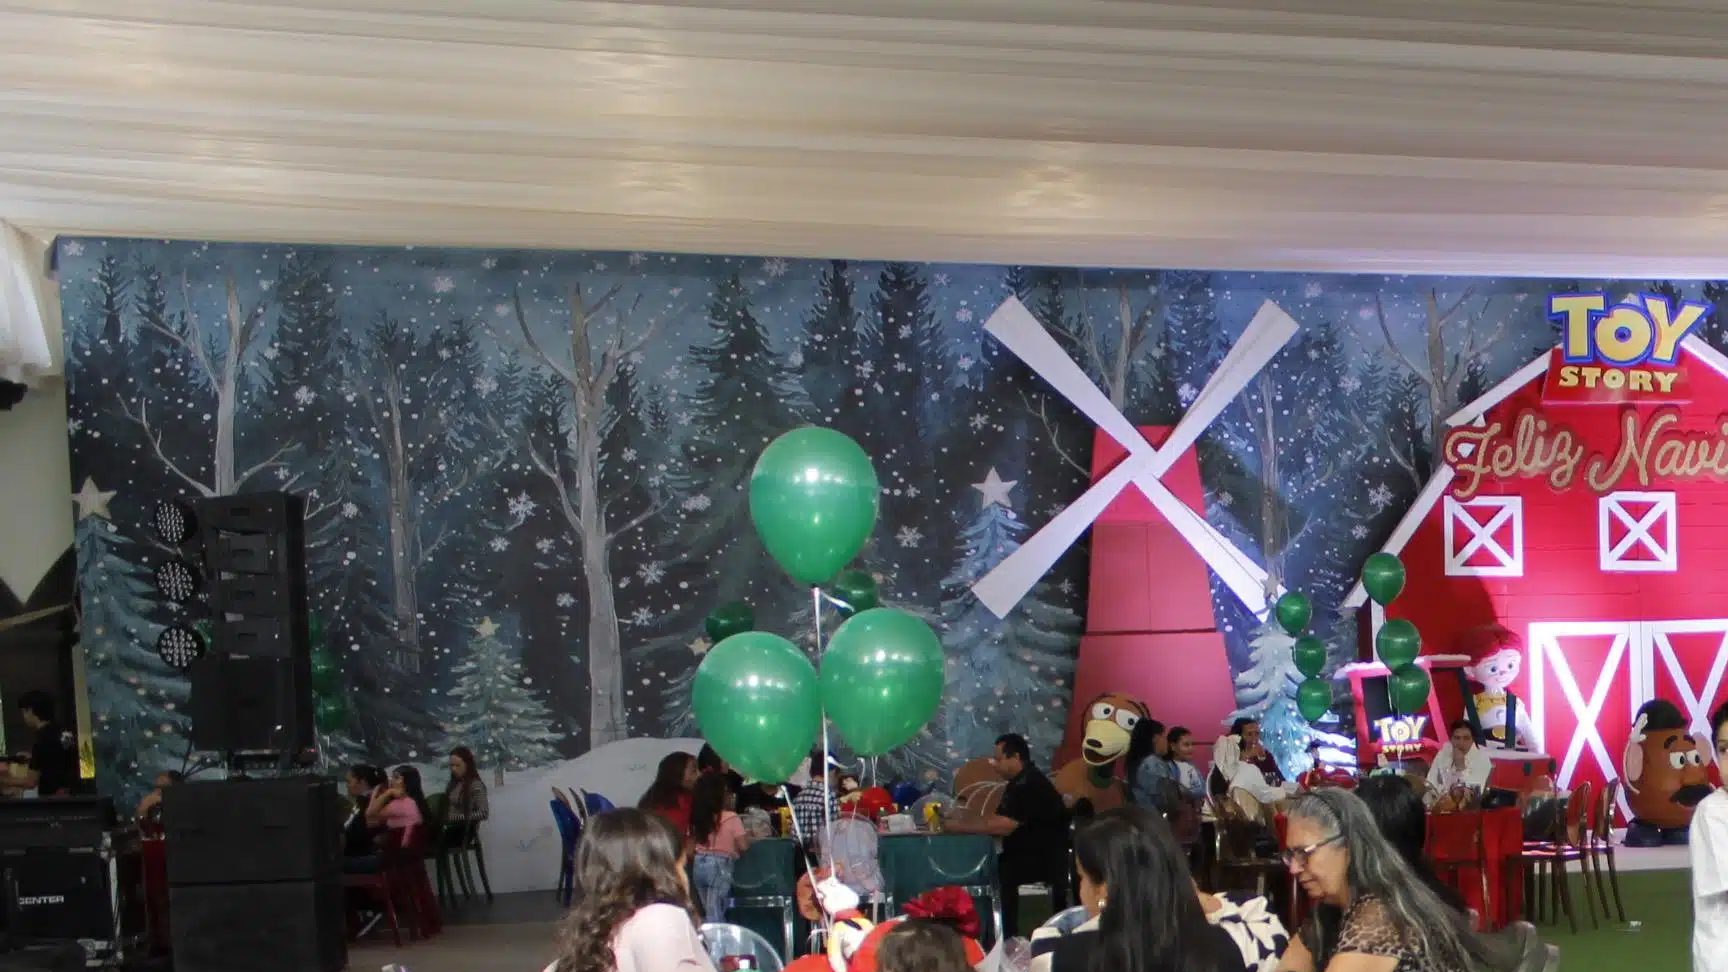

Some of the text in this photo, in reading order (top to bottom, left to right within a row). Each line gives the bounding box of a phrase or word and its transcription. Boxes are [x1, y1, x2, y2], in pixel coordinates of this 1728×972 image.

[1549, 293, 1711, 364] TOY
[1559, 366, 1678, 392] STORY
[1446, 414, 1583, 497] Feliz
[1373, 715, 1426, 742] TOY
[1382, 744, 1423, 753] STORY
